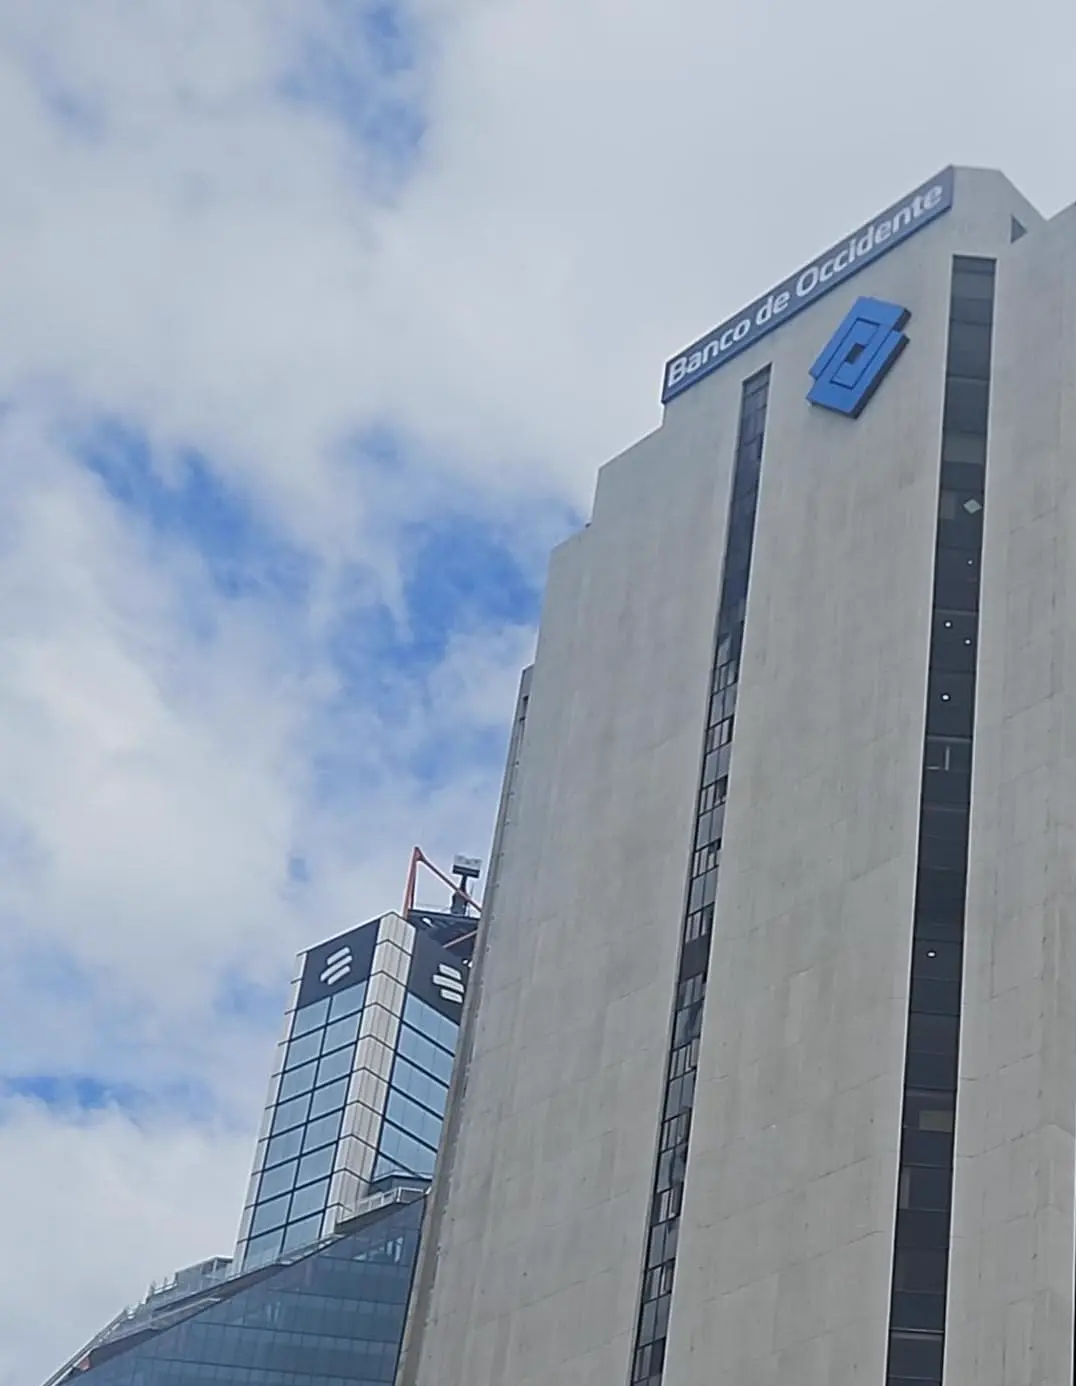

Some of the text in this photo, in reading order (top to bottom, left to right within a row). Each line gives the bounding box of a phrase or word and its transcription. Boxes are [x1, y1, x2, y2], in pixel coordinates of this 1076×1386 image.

[667, 185, 943, 388] Banco de Occidente
